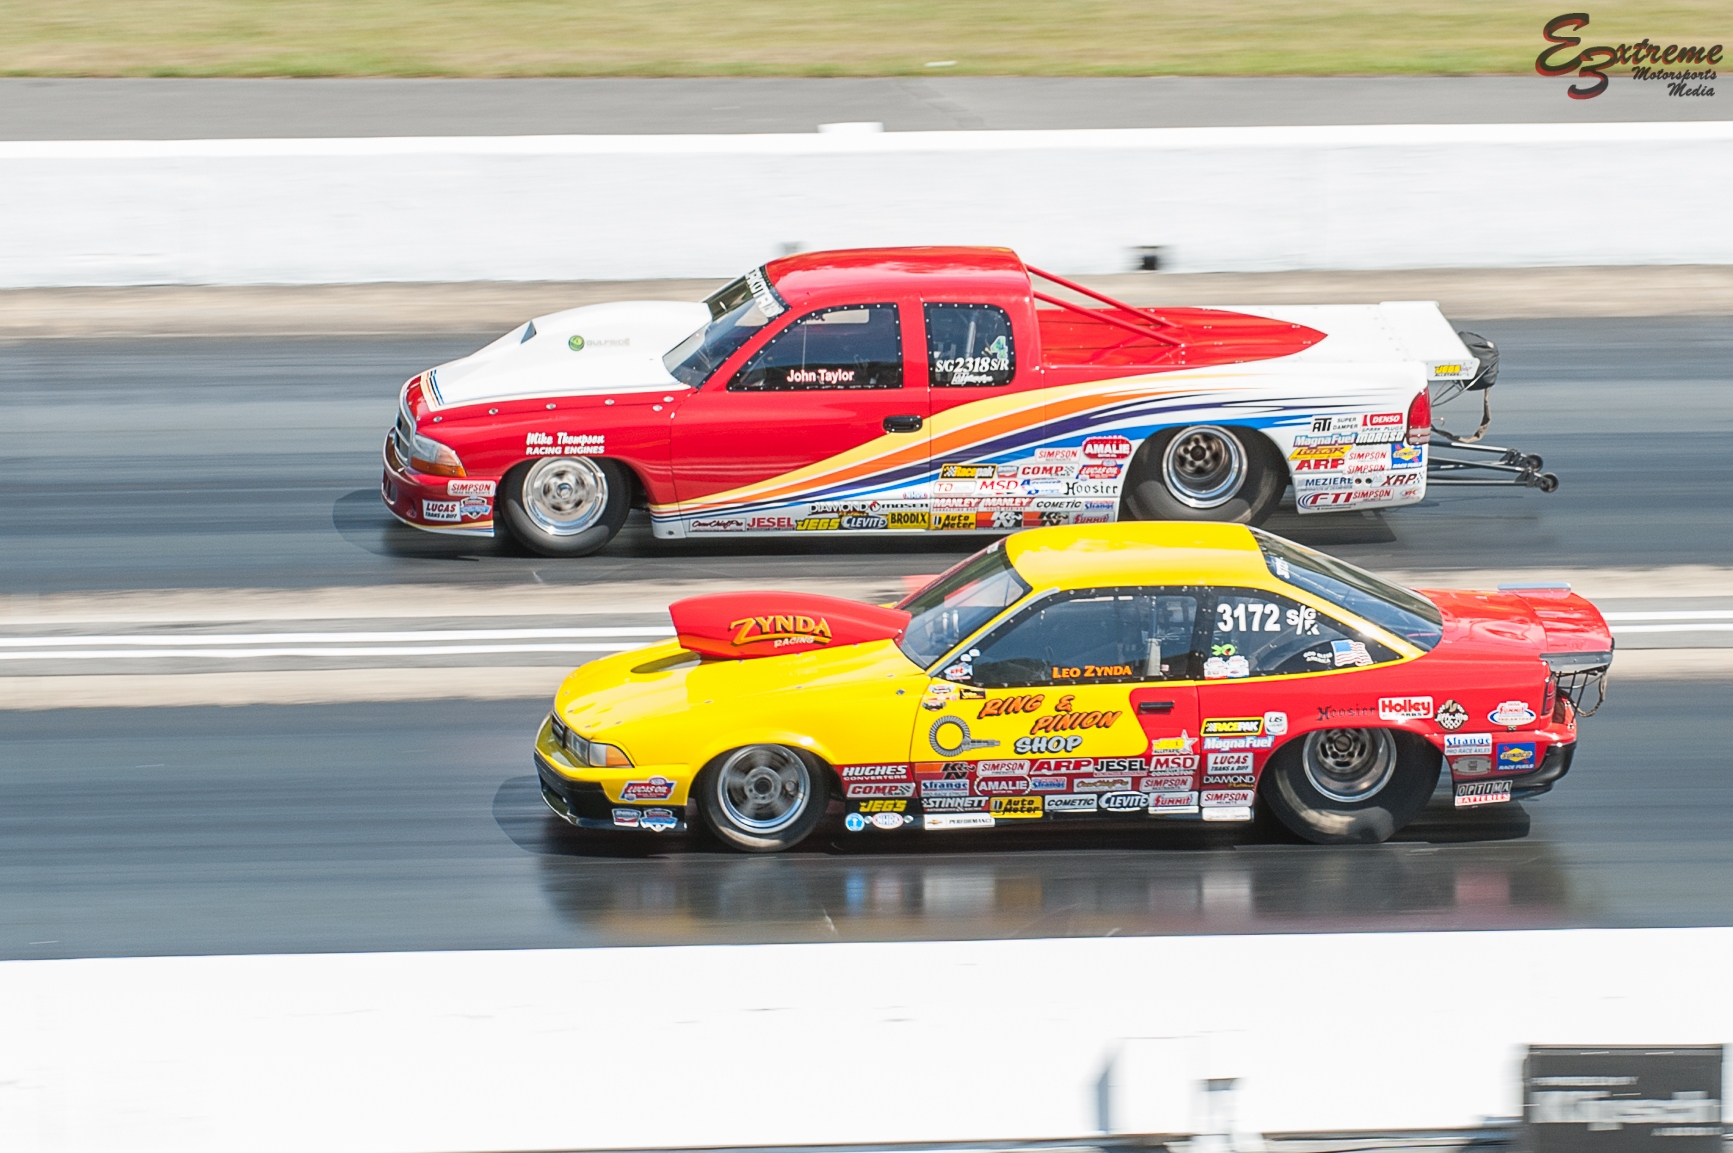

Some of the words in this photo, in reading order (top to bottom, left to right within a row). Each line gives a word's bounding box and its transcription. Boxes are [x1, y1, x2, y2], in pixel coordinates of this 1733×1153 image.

[953, 357, 990, 373] 2318
[786, 369, 816, 382] John
[818, 368, 855, 384] Taylor
[1312, 417, 1332, 432] ATI
[1372, 415, 1400, 424] DENSO
[526, 432, 553, 445] Mike
[557, 432, 605, 446] Thompson
[526, 446, 562, 455] RACING
[564, 446, 605, 454] ENGINES
[1085, 444, 1131, 454] AMALIE
[1039, 450, 1077, 459] SIMPSON
[1348, 452, 1386, 460] SIMPSON
[1295, 459, 1345, 471] ARP
[1347, 464, 1385, 473] SIMPSON
[1022, 466, 1064, 475] COMP
[1305, 477, 1353, 486] MEZIERE
[1381, 473, 1418, 486] XRP
[451, 483, 491, 492] SIMPSON
[980, 480, 1018, 490] MSD
[1063, 481, 1118, 495] Hoosier
[1310, 492, 1353, 505] FTI
[1352, 489, 1391, 499] SIMPSON
[426, 502, 456, 513] LUCAS
[809, 502, 868, 512] DIAMOND
[933, 498, 981, 508] MANLEY
[984, 498, 1034, 508] MANLEY
[1037, 499, 1081, 508] COMETIC
[747, 517, 795, 528] JESEL
[842, 515, 888, 529] CLEVITE
[890, 513, 927, 524] BRODIX
[942, 521, 974, 529] Meter
[1217, 604, 1281, 632] 3172
[728, 615, 832, 647] ZYNDA
[774, 636, 815, 648] RACING
[1052, 667, 1080, 678] LEO
[1084, 665, 1132, 677] ZYNDA
[977, 694, 1045, 719] RING
[1055, 694, 1075, 713] &
[1381, 699, 1431, 716] Holley
[1030, 710, 1122, 735] PINION
[1014, 735, 1083, 754] SHOP
[1204, 735, 1274, 751] MagnaFuel
[1154, 757, 1195, 770] MSD
[1213, 755, 1249, 764] LUCAS
[842, 765, 908, 776] HUGHES
[982, 763, 1025, 771] SIMPSON
[1034, 760, 1092, 771] ARP
[1094, 760, 1148, 772] JESEL
[1144, 778, 1188, 788] SIMPSON
[1203, 775, 1255, 783] DIAMOND
[851, 786, 899, 794] COMP
[979, 781, 1027, 790] AMALIE
[1457, 781, 1512, 796] OPTIMA
[923, 797, 989, 807] STINNETT
[1047, 797, 1094, 806] COMETIC
[1099, 793, 1148, 808] CLEVITE
[1205, 793, 1249, 801] SIMPSON
[1457, 794, 1510, 804] BATTERIES
[1003, 806, 1040, 815] Meter
